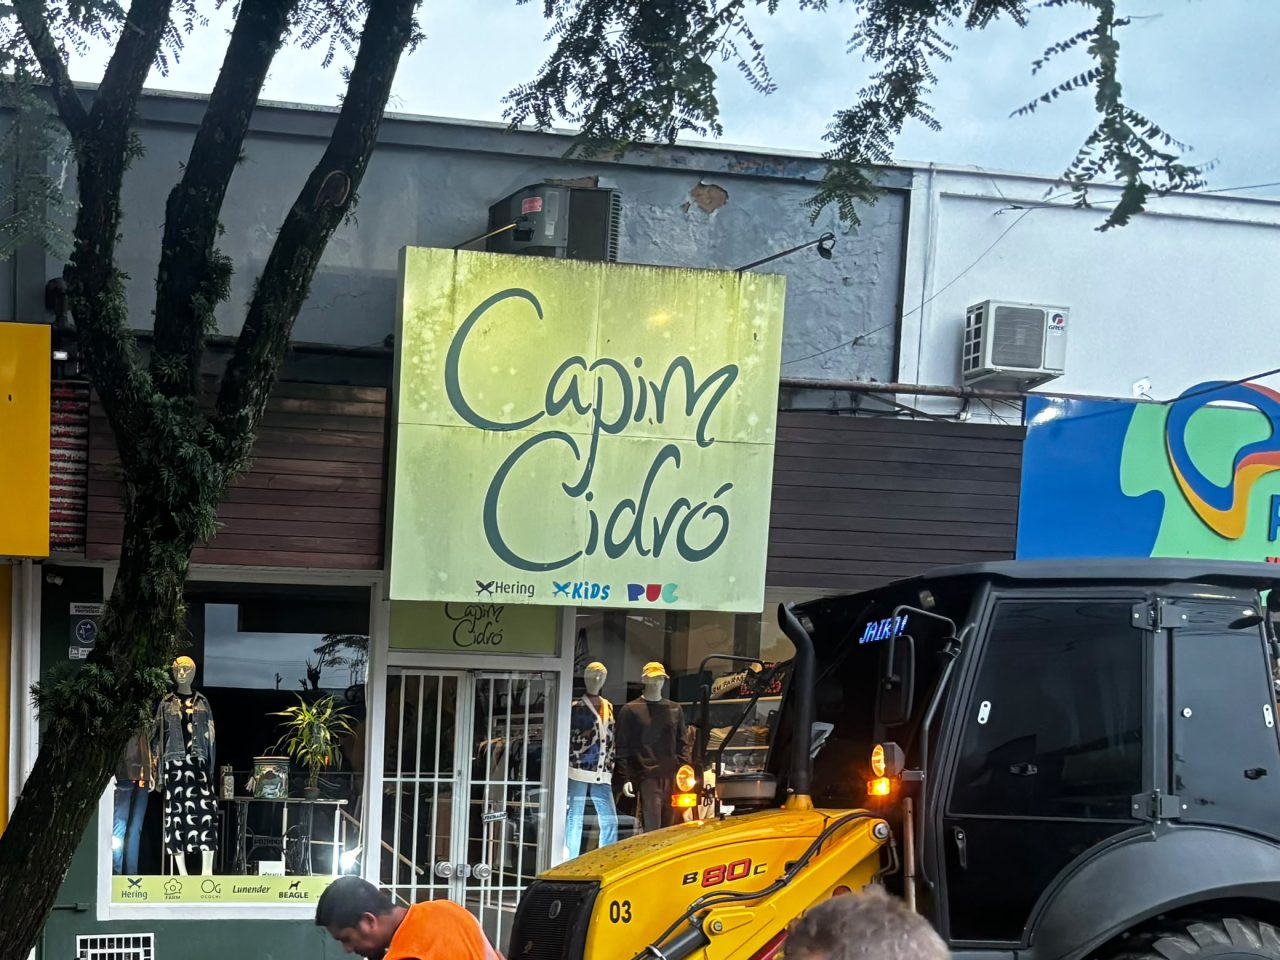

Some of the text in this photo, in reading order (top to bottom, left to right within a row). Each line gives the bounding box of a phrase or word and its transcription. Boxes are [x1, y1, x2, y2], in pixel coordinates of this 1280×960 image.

[444, 287, 739, 498] Capim
[483, 430, 733, 572] Cidró
[495, 581, 535, 597] Hering
[627, 583, 679, 604] PUC
[453, 619, 503, 647] Cidró
[121, 890, 148, 900] Hering
[232, 885, 271, 893] Lunender
[278, 891, 309, 899] BEAGLE
[609, 900, 632, 923] 03
